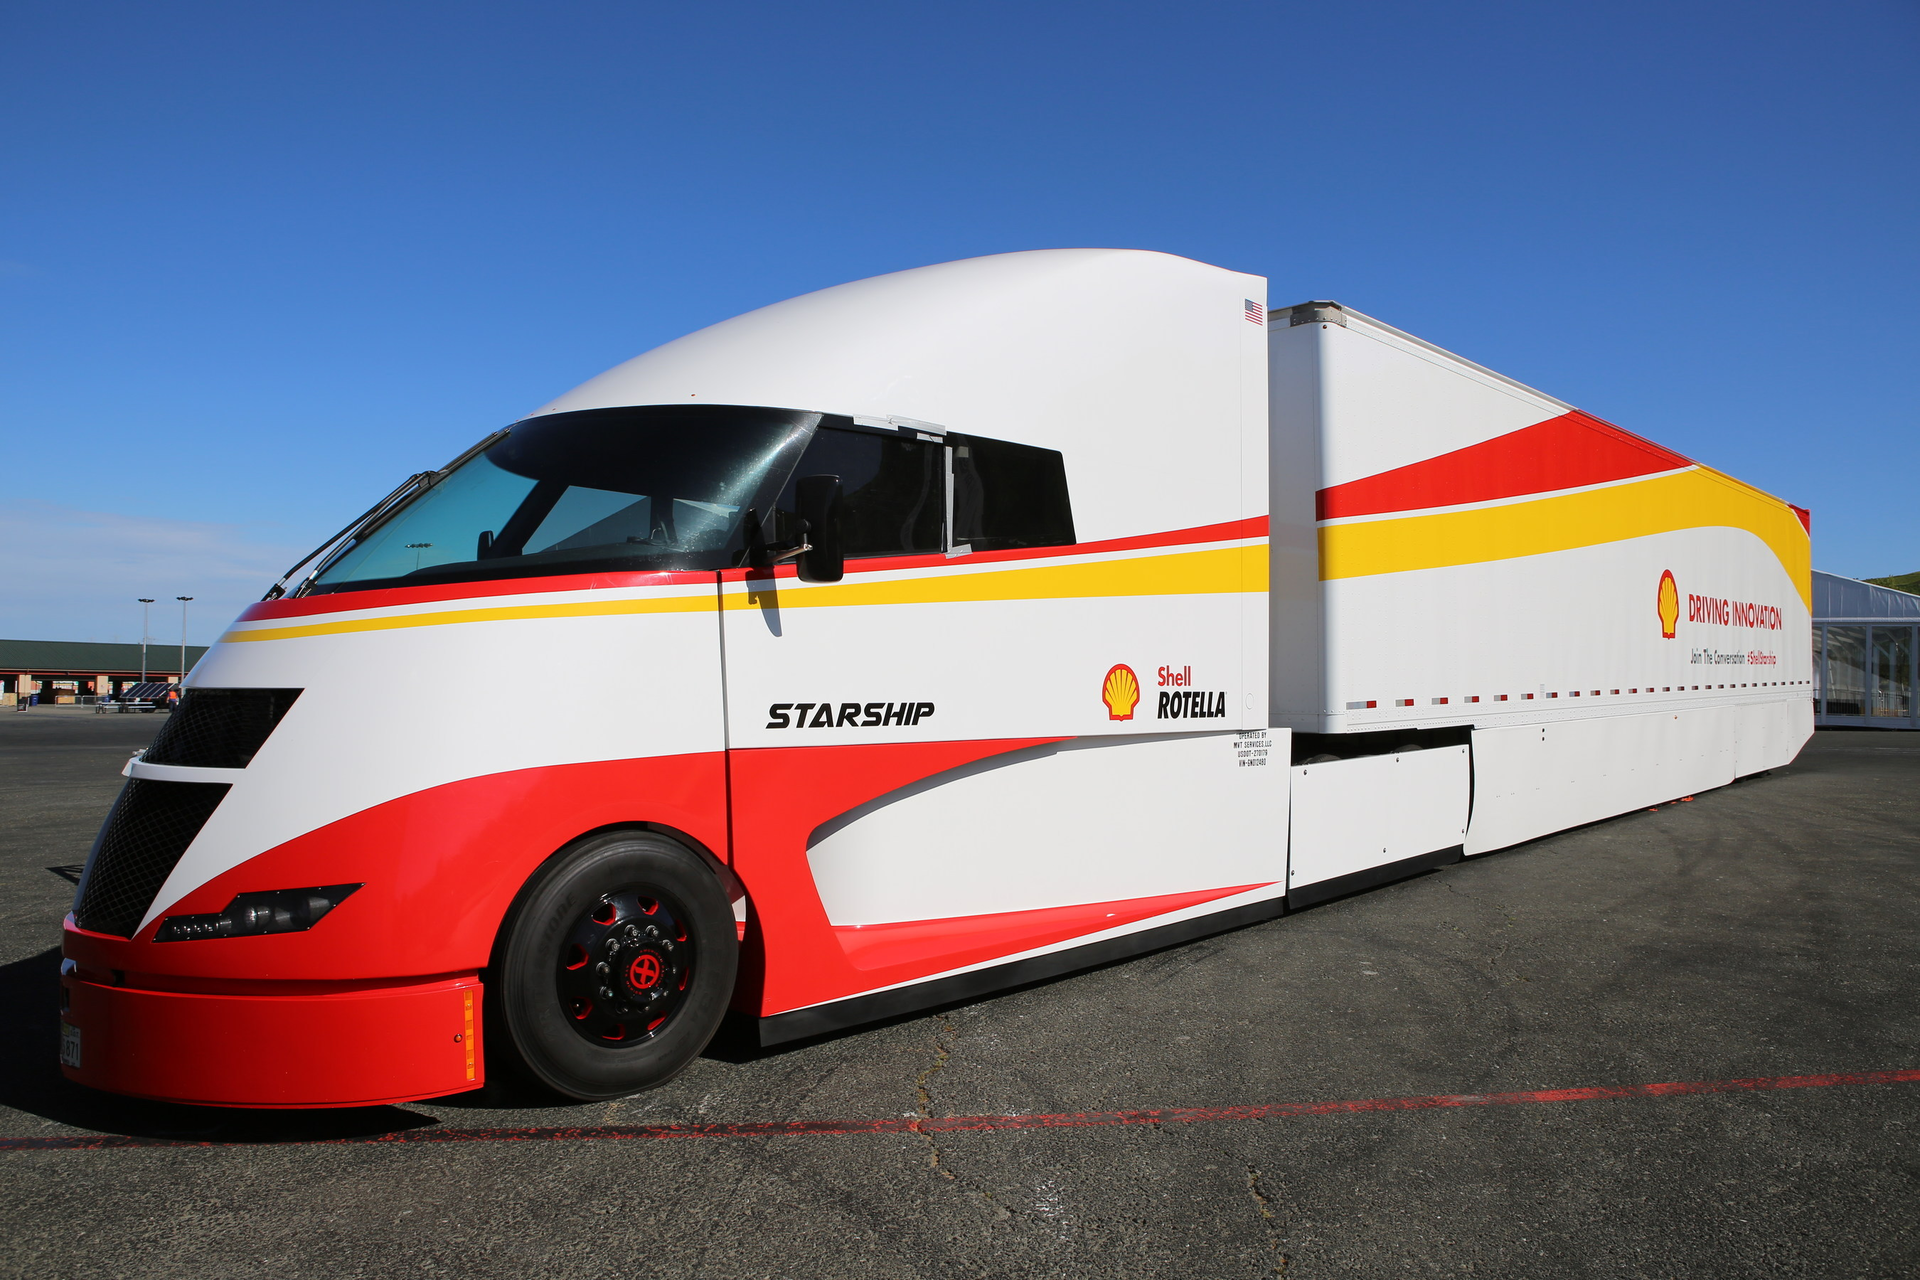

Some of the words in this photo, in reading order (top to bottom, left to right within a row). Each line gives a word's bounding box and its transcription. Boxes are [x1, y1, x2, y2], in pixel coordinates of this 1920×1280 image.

[1688, 593, 1730, 626] DRIVING
[1732, 600, 1782, 630] INNOVATION
[1690, 648, 1702, 664] Join
[1703, 647, 1713, 664] The
[1714, 649, 1745, 665] Conversation
[1157, 665, 1192, 687] Shell
[765, 702, 936, 730] STARSHIP
[1157, 690, 1226, 719] ROTELLA
[1239, 731, 1260, 740] OPERATED
[1261, 731, 1267, 739] BY
